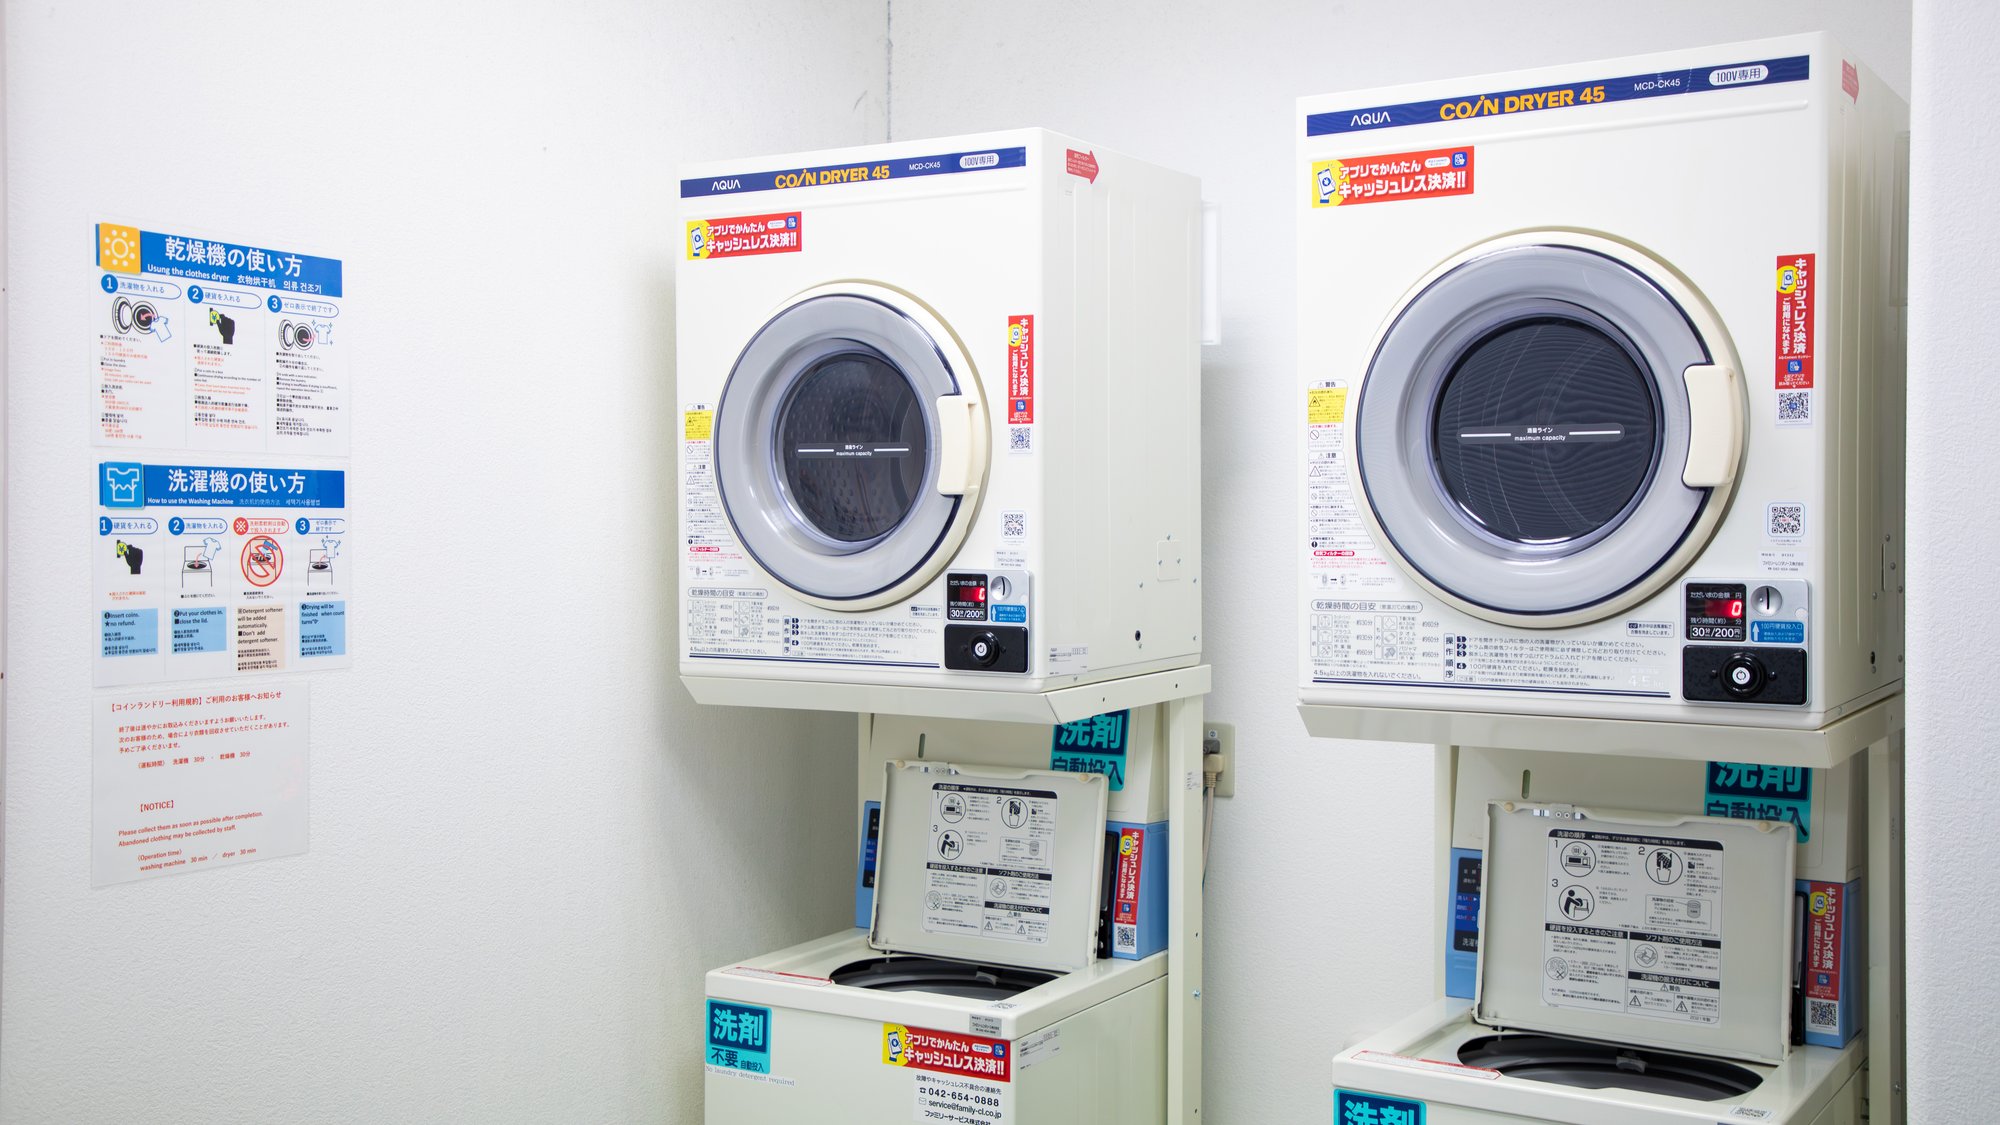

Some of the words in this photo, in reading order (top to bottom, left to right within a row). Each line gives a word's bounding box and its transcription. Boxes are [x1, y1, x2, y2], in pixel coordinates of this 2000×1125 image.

[1717, 68, 1760, 83] 100V専用
[1351, 111, 1391, 126] AQUA
[1505, 90, 1574, 112] DRYER
[1580, 86, 1605, 103] 45
[1634, 78, 1680, 91] MCD-CK45
[965, 156, 994, 166] 100V専用
[712, 180, 740, 191] AQUA
[820, 167, 868, 184] DRYER
[872, 165, 890, 179] 45
[909, 161, 940, 170] MCD-CK45
[1339, 160, 1421, 179] アプリでかんたん
[707, 222, 765, 236] アプリでかんたん
[165, 236, 302, 277] 乾燥機の使い方
[172, 267, 183, 275] the
[185, 269, 210, 279] clothes
[212, 272, 229, 282] dryer
[106, 277, 113, 289] 1
[120, 282, 165, 294] 洗濯物を入れる
[192, 288, 199, 299] 2
[205, 292, 241, 302] 硬貨を入れる
[271, 298, 278, 308] 3
[284, 302, 333, 314] ゼロ表示で終了です
[1794, 258, 1807, 354] キャッシュレス決済
[1782, 297, 1791, 355] ご利用になれます
[1020, 318, 1028, 396] キャッシュレス決済
[168, 468, 306, 494] 洗濯機の使い方
[101, 520, 107, 531] 1
[114, 522, 152, 530] 硬貨を入れる
[173, 520, 180, 531] 2
[300, 521, 305, 530] 3
[1316, 602, 1376, 610] 乾燥時間の目安
[1732, 601, 1742, 616] 0
[112, 697, 202, 712] 【コインランドリー利用規約】
[206, 691, 281, 704] ご利用のお客様へお知らせ
[1060, 714, 1122, 748] 洗剤
[119, 742, 181, 754] 予めご了承くださいませ。
[140, 800, 174, 812] 【NOTICE】
[997, 796, 1002, 804] 2
[138, 826, 156, 834] collect
[200, 817, 221, 825] possible
[235, 812, 263, 821] completion.
[118, 838, 149, 846] Abandoned
[193, 828, 215, 836] collected
[1557, 831, 1586, 839] 洗濯の順序
[1639, 847, 1645, 855] 2
[140, 863, 162, 871] washing
[164, 859, 186, 867] machine
[1126, 832, 1139, 899] キャッシュレス決済
[1552, 879, 1558, 887] 3
[1550, 924, 1623, 937] 硬貨を投入するときのご注意
[1823, 887, 1836, 969] キャッシュレス決済
[1646, 935, 1702, 946] ソフト剤のご使用方法
[1641, 973, 1709, 988] 洗濯機の据え付けについて
[713, 1008, 763, 1046] 洗剤
[905, 1033, 970, 1052] アプリでかんたん
[712, 1047, 738, 1068] 不要
[741, 1060, 764, 1072] 自動投入
[715, 1067, 736, 1076] laundry
[739, 1072, 766, 1081] detergent
[769, 1078, 794, 1086] required
[916, 1075, 1002, 1095] 故障やキャッシュレス不具合の連絡先
[928, 1087, 999, 1107] 042-654-0888
[929, 1099, 1001, 1119] service@family-cl.co.jp
[925, 1110, 991, 1125] ファミリーサービス株式会社
